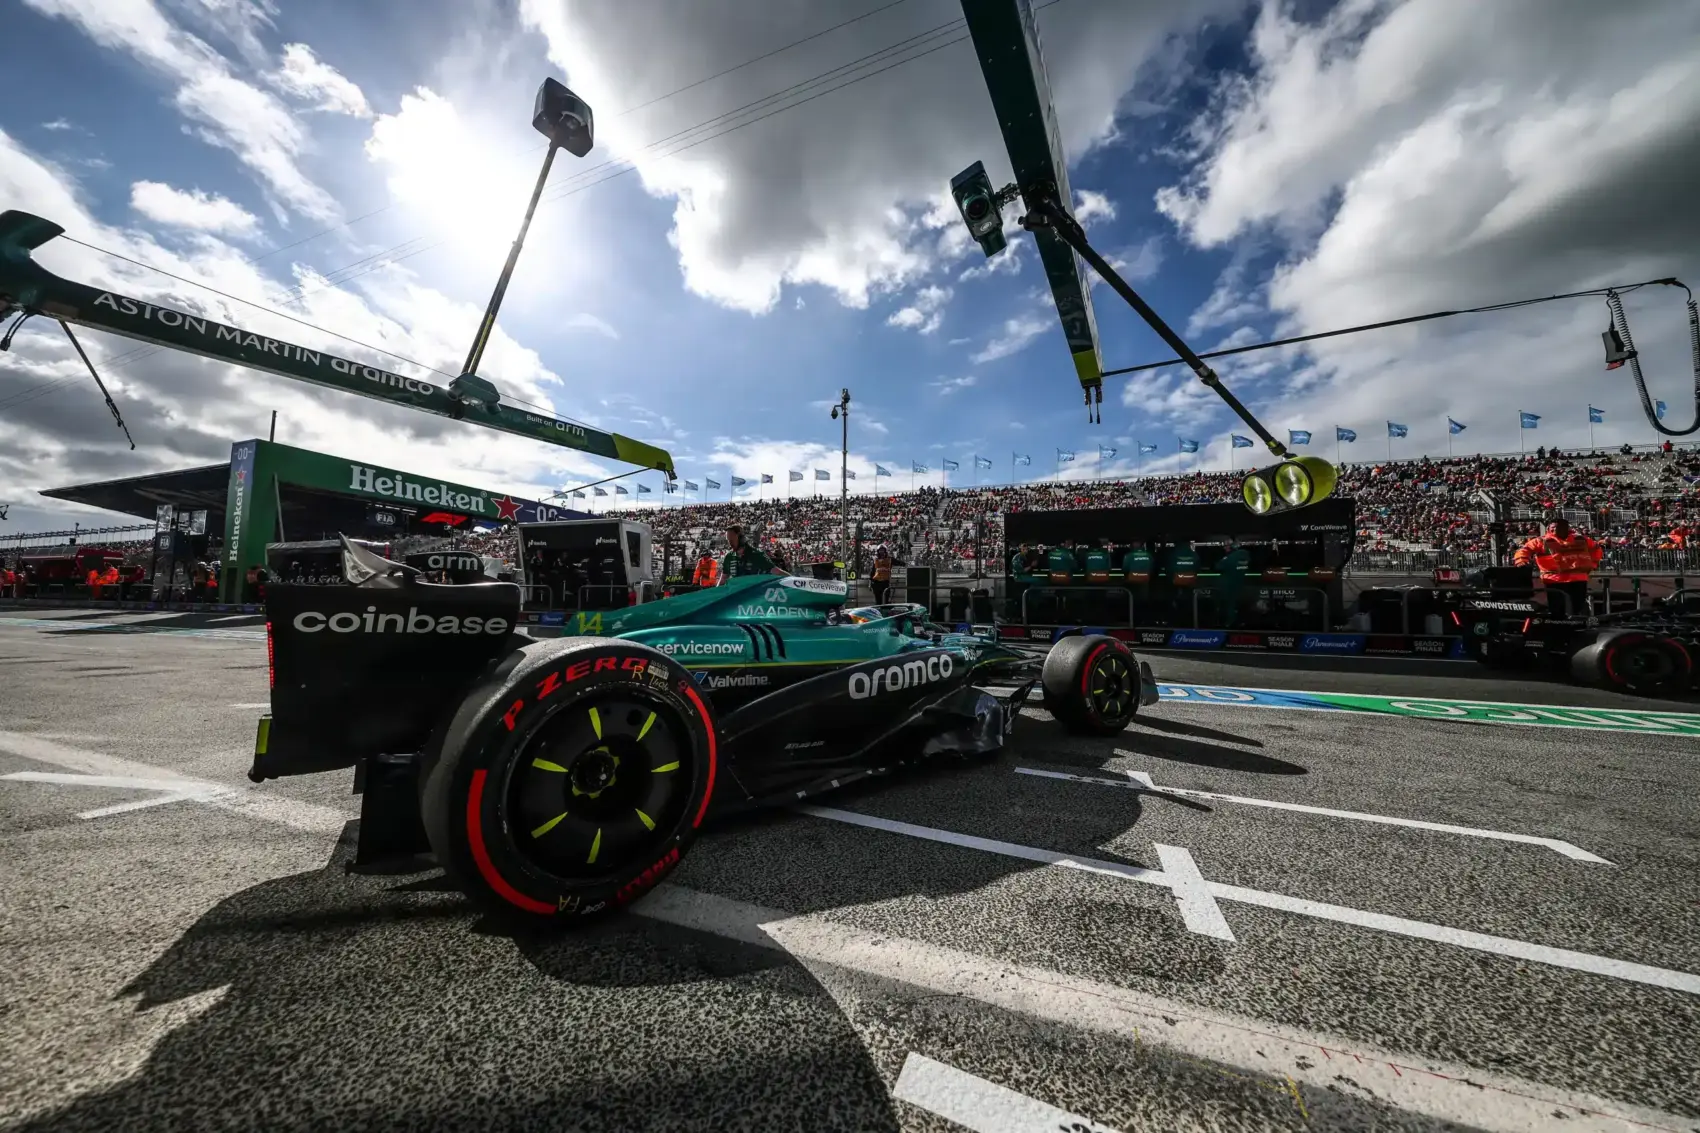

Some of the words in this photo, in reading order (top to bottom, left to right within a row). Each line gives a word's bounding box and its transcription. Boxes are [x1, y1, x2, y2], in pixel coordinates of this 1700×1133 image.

[93, 292, 207, 335] ASTON
[215, 325, 321, 366] MARTIN
[331, 357, 434, 396] aramco
[526, 414, 543, 424] Built
[555, 421, 585, 437] arm
[229, 485, 244, 562] Heineken
[427, 555, 479, 571] arm
[808, 581, 847, 594] CoreWeave
[293, 605, 508, 635] coinbase
[738, 605, 809, 618] MAADEN
[577, 612, 604, 635] 14
[656, 641, 744, 655] servicenow
[1173, 632, 1219, 645] Paramount+
[1304, 637, 1358, 649] Paramount+
[848, 653, 953, 700] aramco
[503, 698, 525, 731] P
[535, 655, 649, 701] ZERO
